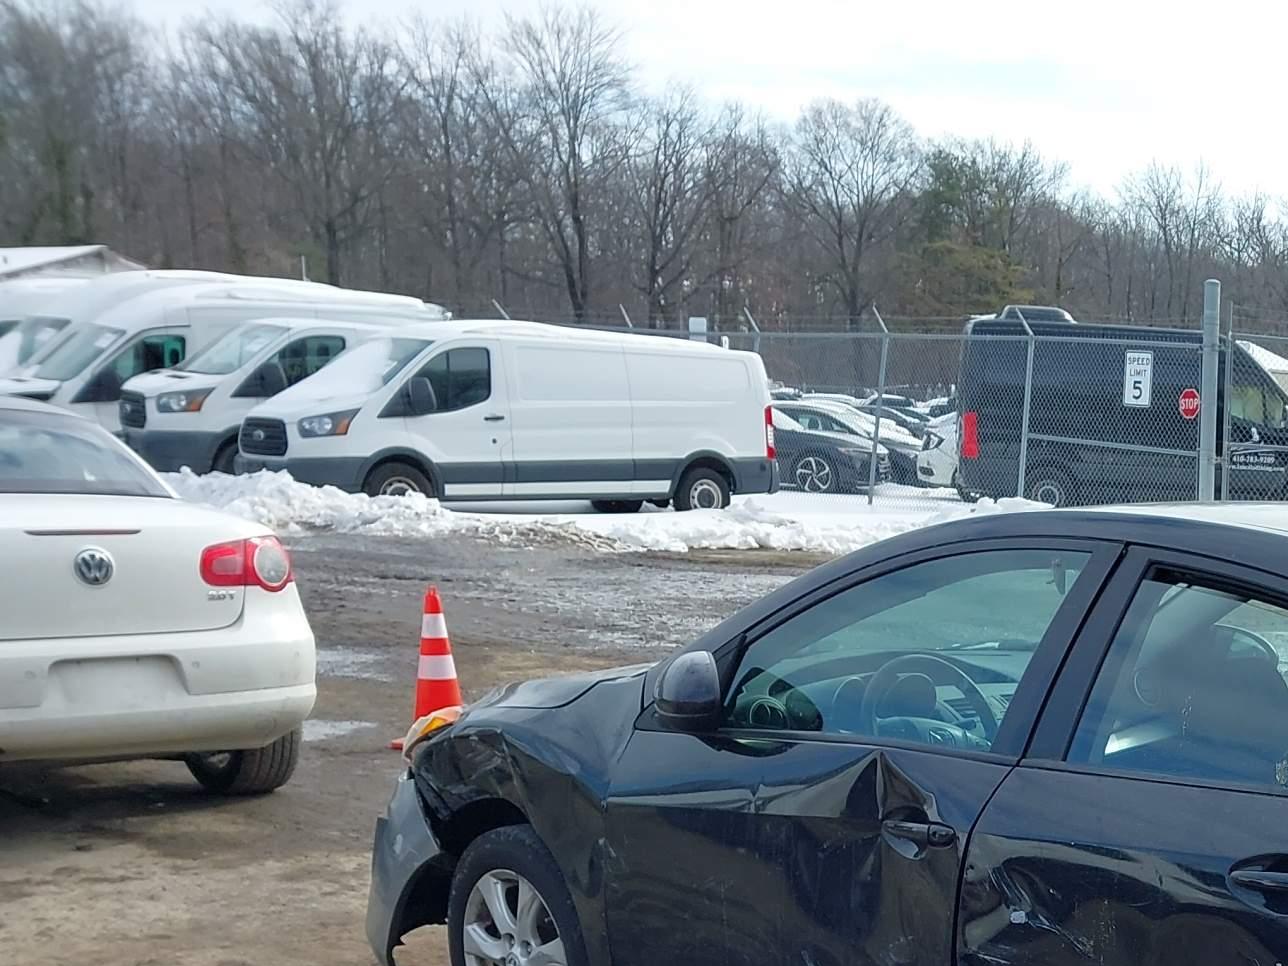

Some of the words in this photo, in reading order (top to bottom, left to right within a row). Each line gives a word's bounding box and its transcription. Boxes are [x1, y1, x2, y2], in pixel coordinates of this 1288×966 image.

[1128, 357, 1150, 366] SPEED
[1130, 369, 1147, 377] LIMIT
[1132, 380, 1143, 400] 5
[1180, 398, 1199, 410] STOP
